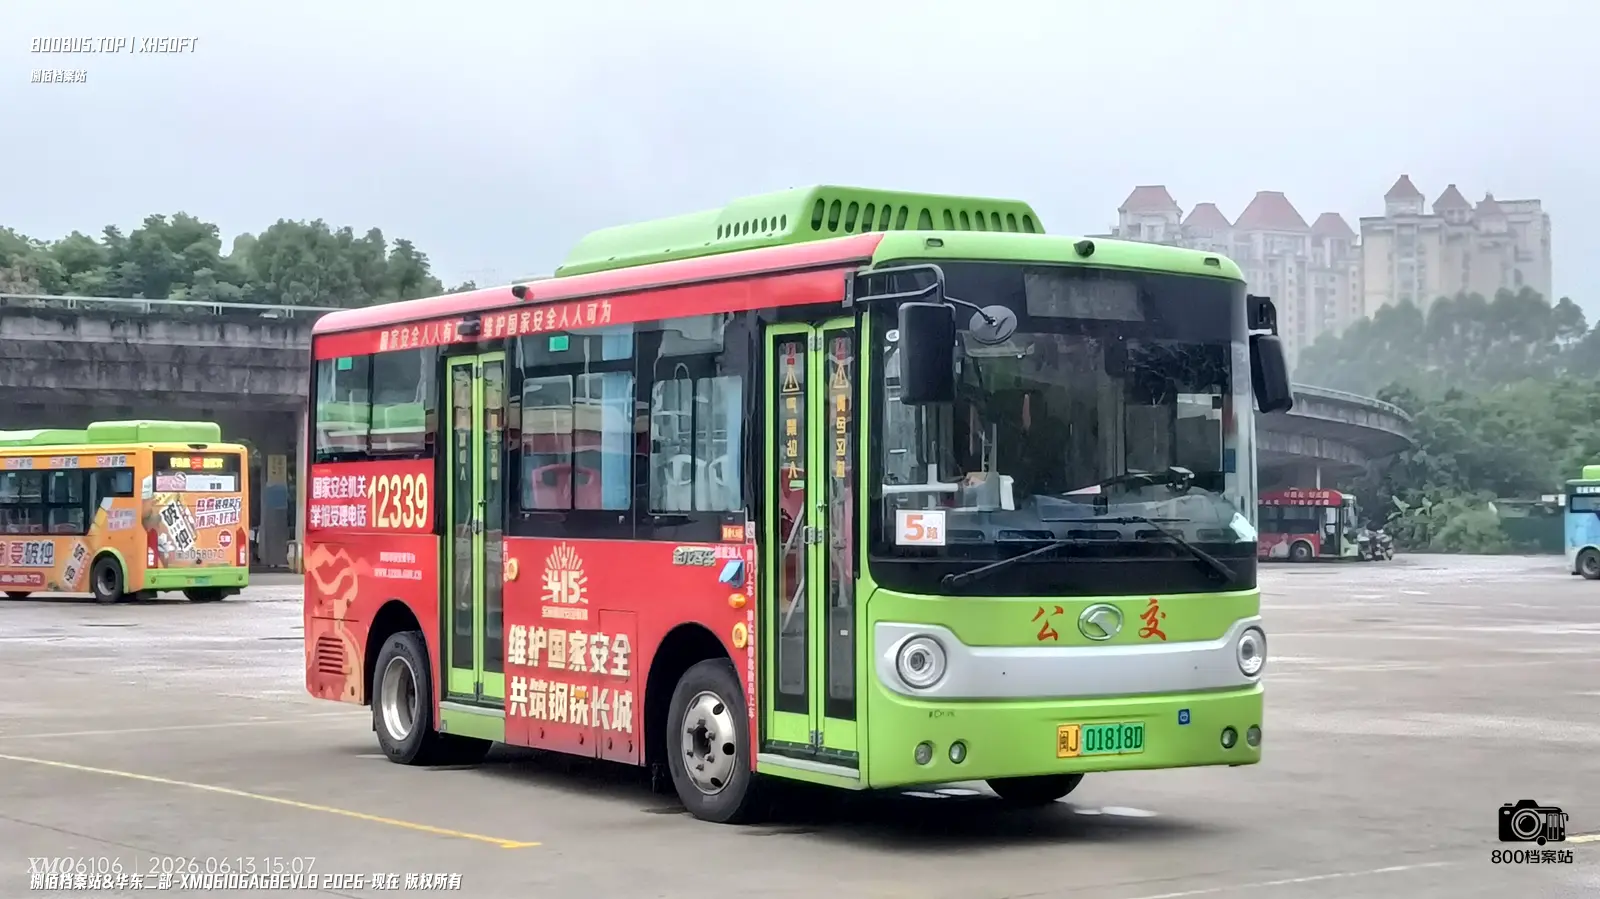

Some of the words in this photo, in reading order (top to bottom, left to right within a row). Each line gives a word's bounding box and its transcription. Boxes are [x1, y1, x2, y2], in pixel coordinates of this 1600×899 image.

[483, 300, 612, 338] 维护国家安全人人可为
[312, 475, 367, 499] 国家安全机关
[368, 473, 428, 529] 12339
[310, 504, 367, 528] 举报受理电话
[508, 624, 631, 677] 维护国家安全
[509, 676, 633, 734] 共筑钢铁长城
